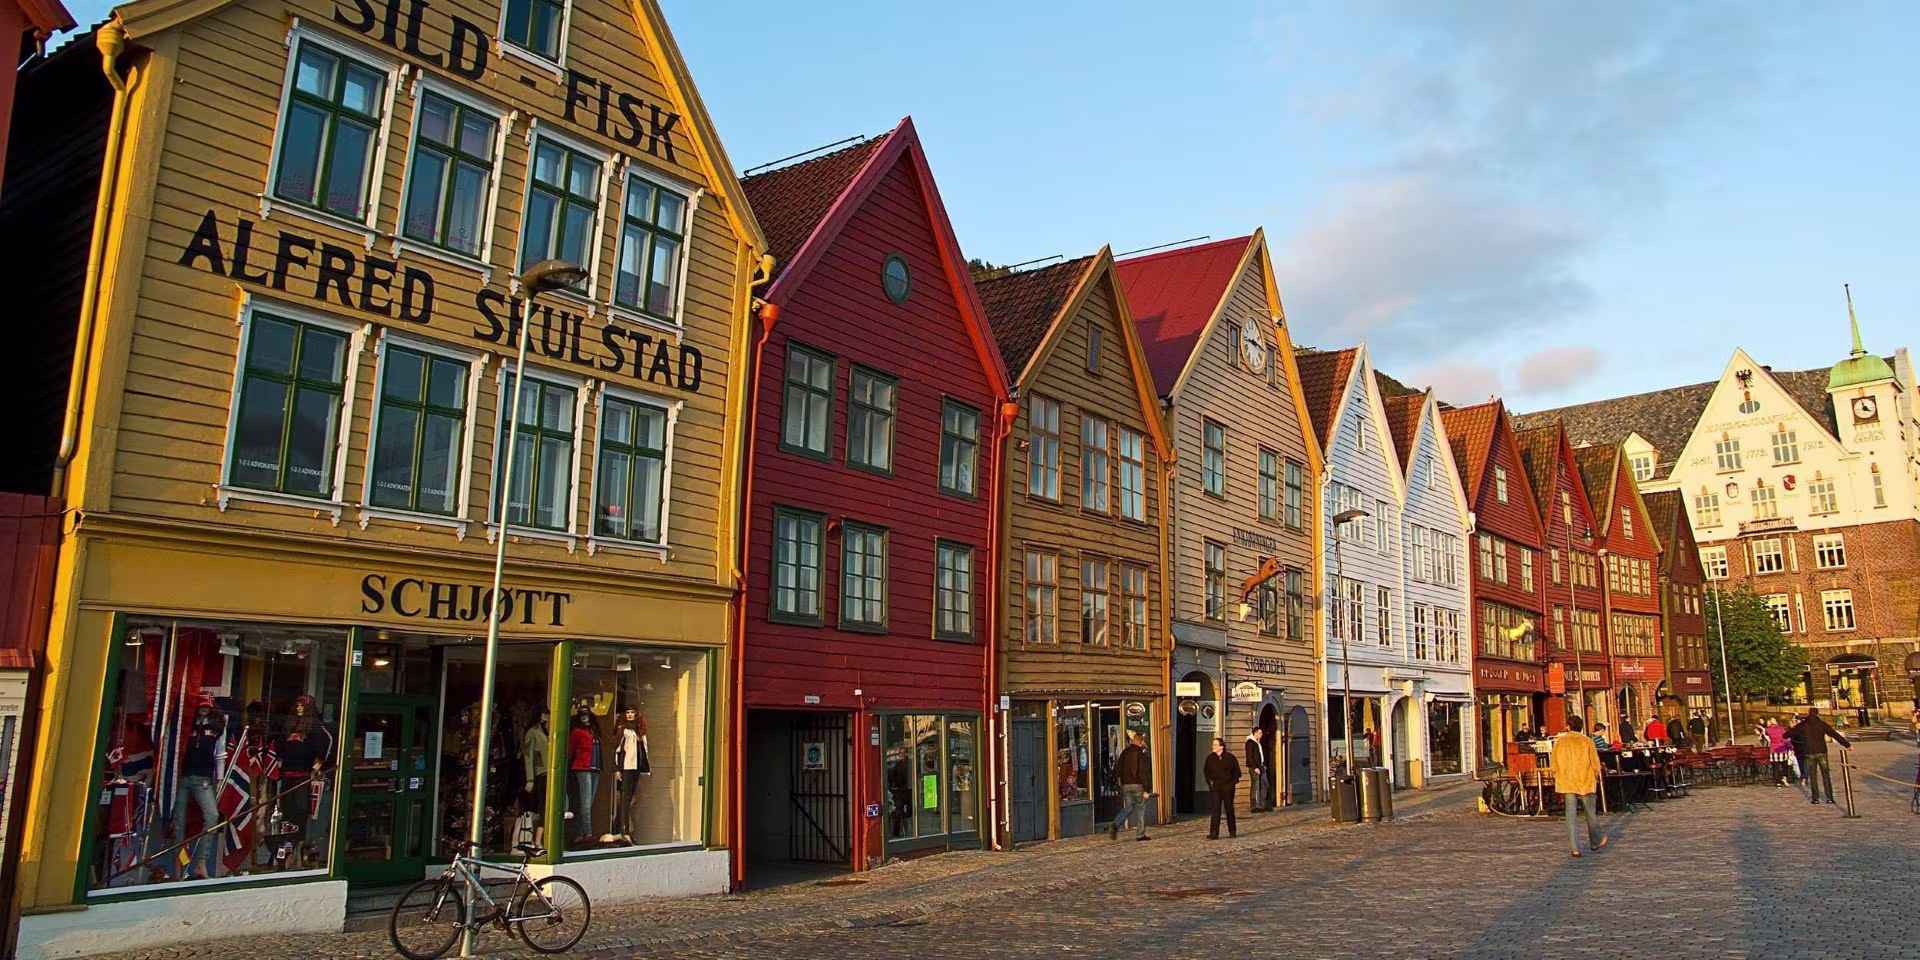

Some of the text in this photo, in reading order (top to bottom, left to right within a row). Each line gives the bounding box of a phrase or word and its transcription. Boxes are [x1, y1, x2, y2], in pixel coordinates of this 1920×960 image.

[563, 70, 681, 164] FISK
[177, 209, 702, 392] ALFRED SKULSTAD
[361, 574, 570, 627] SCHJØTT
